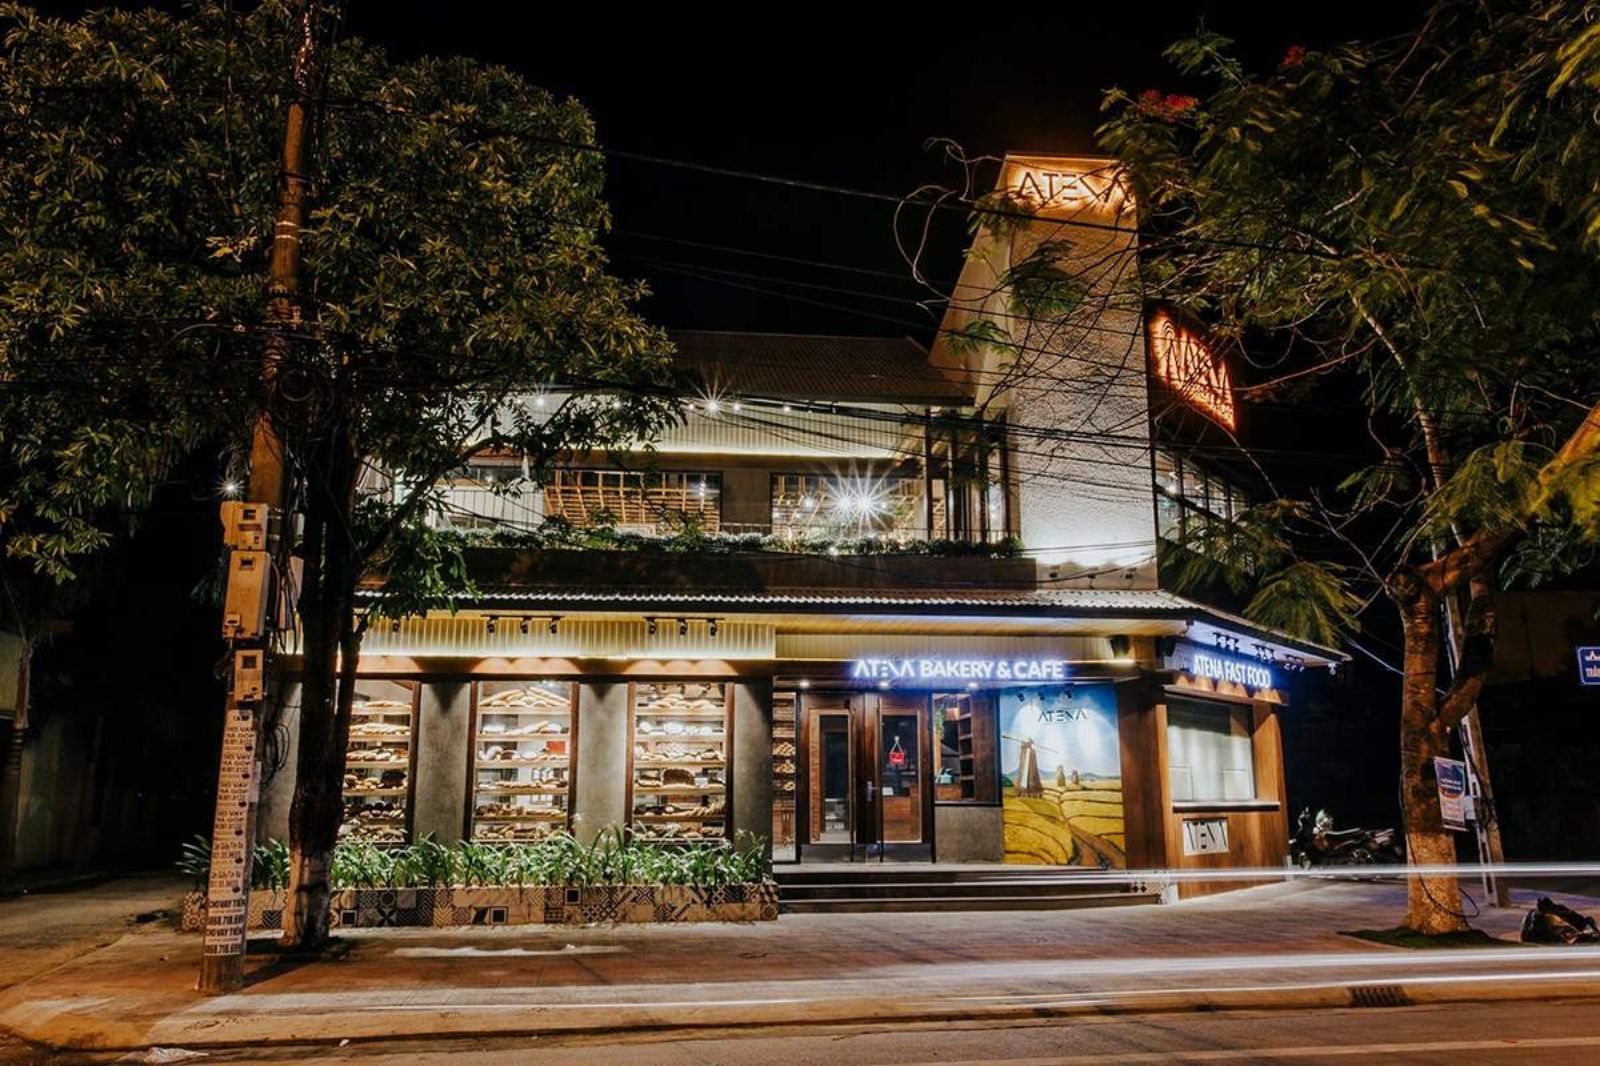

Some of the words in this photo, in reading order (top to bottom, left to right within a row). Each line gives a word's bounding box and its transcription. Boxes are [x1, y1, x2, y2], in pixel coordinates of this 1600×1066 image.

[1018, 172, 1131, 202] ATENA
[853, 659, 915, 677] ATENA
[920, 660, 995, 678] BAKERY
[996, 660, 1011, 678] &
[1193, 653, 1224, 681] ATENA
[1224, 660, 1247, 684] FAST
[1247, 666, 1272, 688] FOOD
[1037, 708, 1088, 723] ATENA
